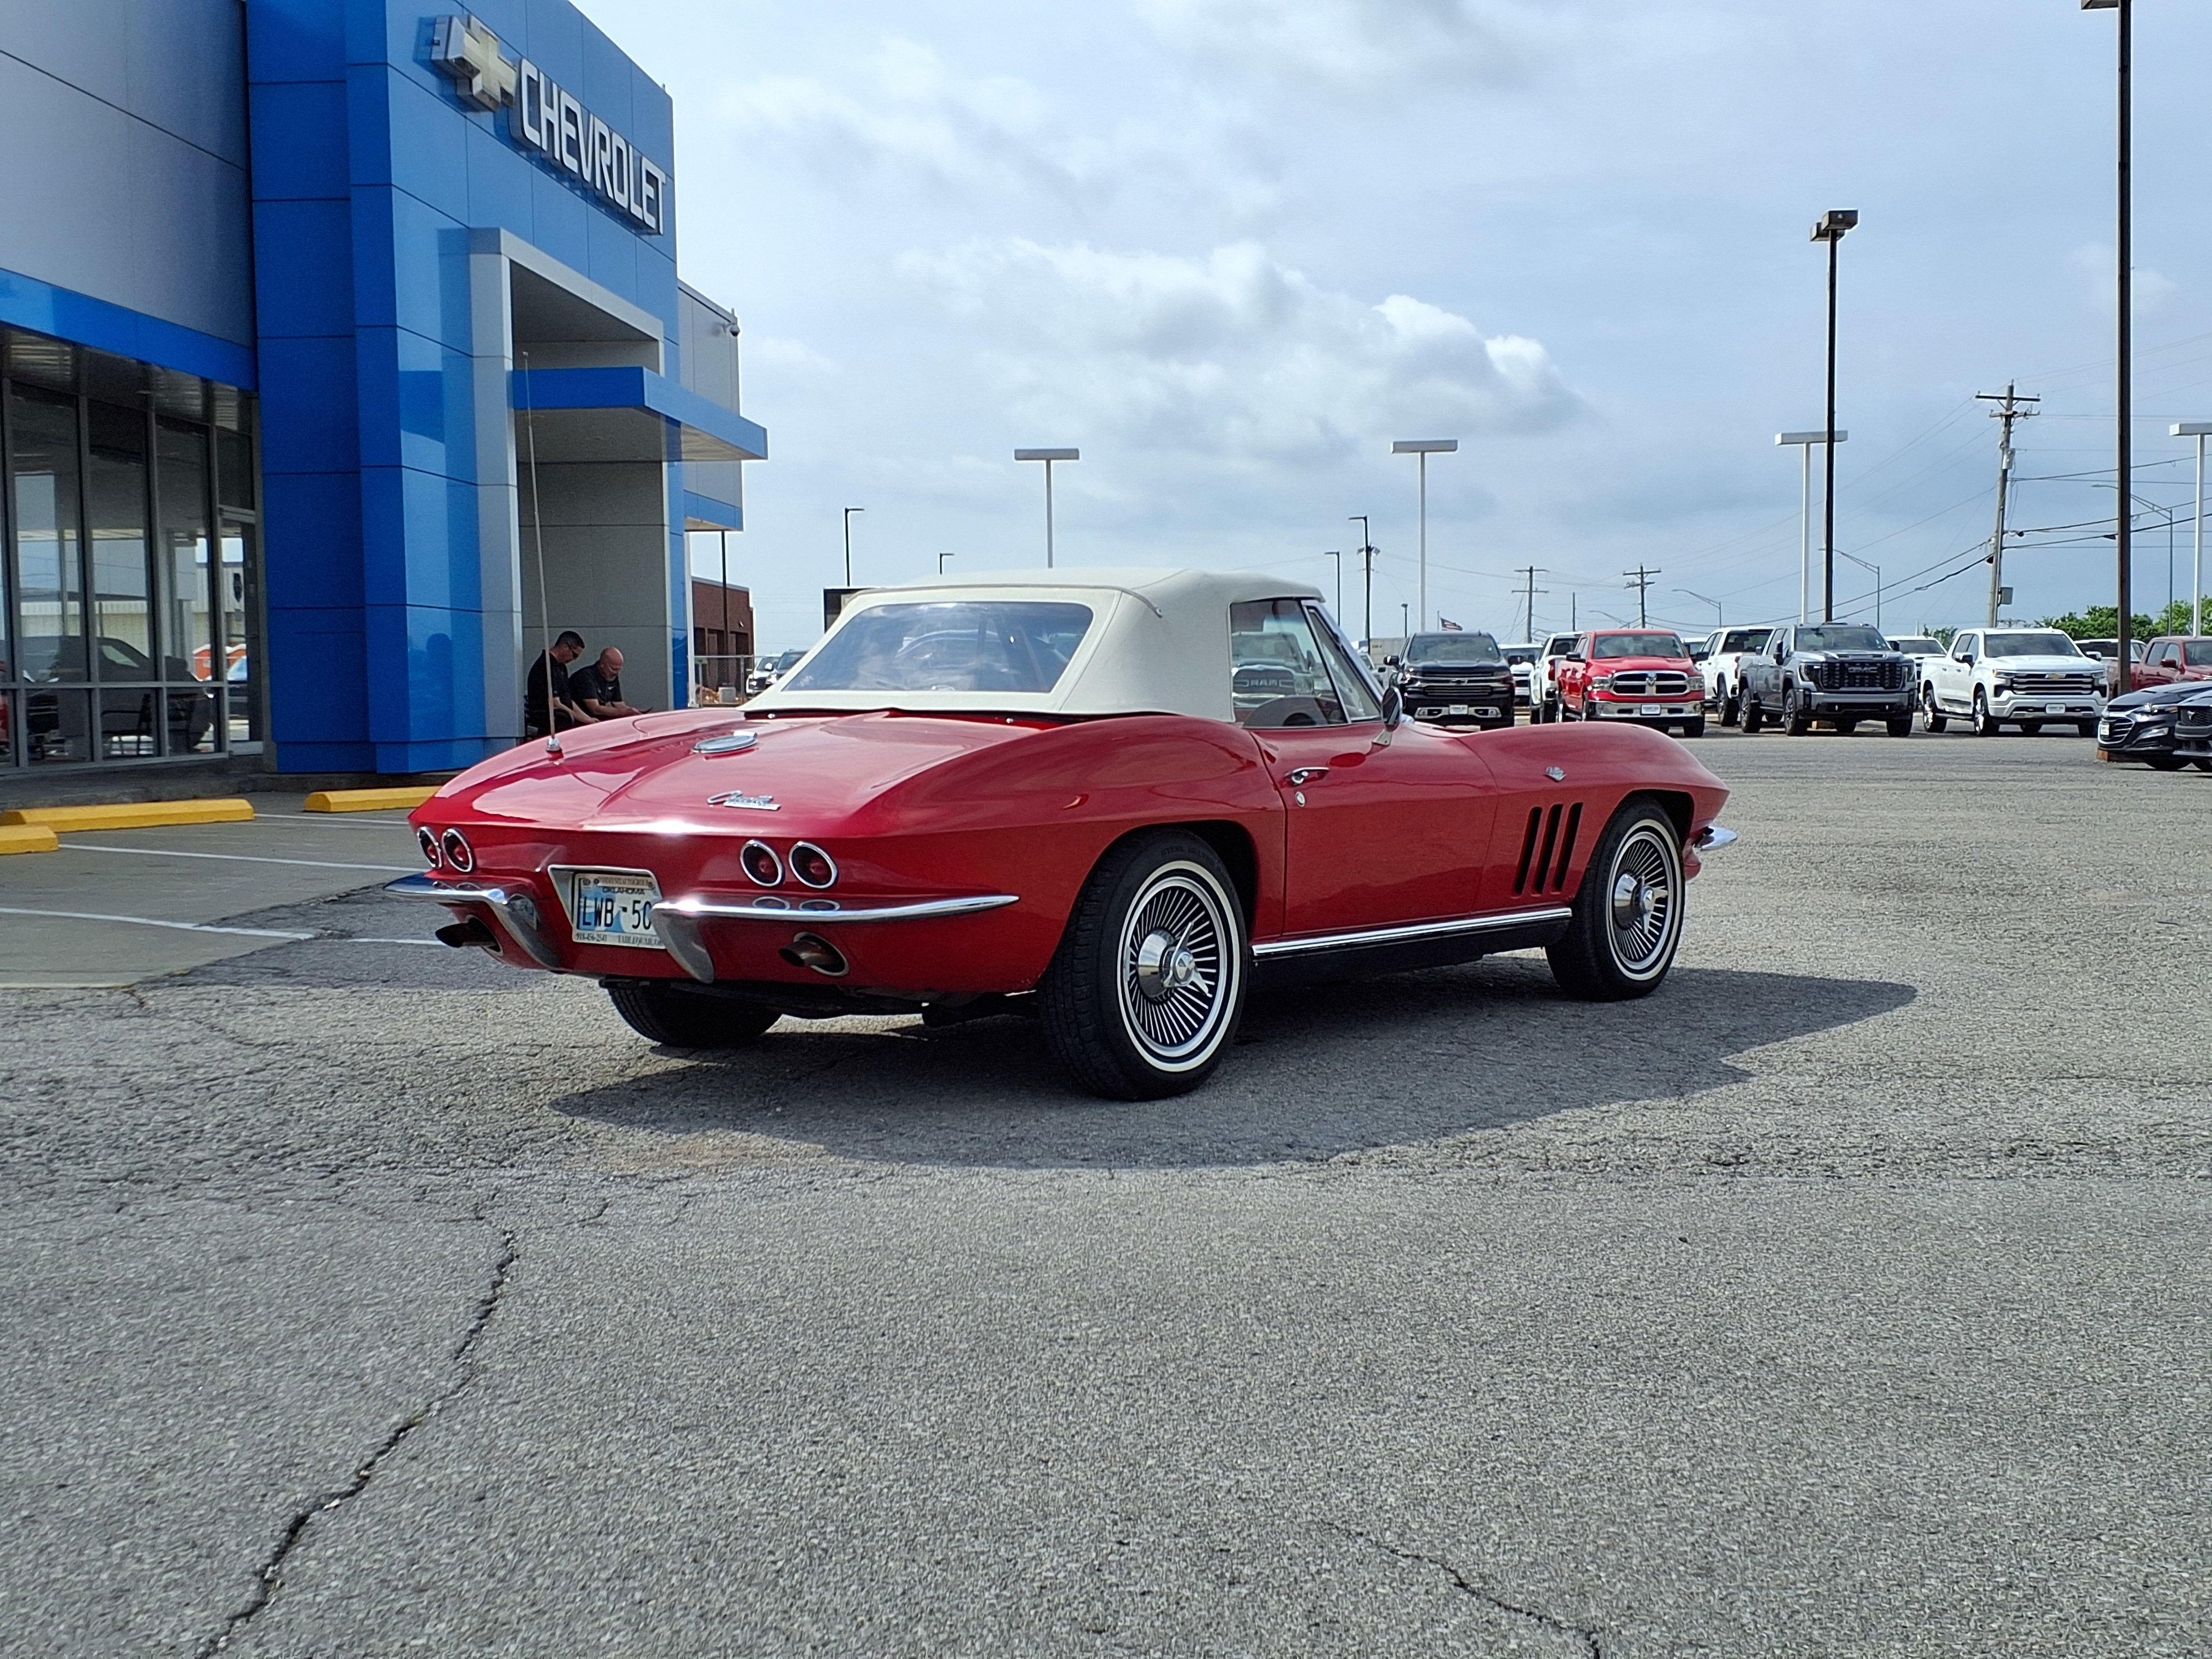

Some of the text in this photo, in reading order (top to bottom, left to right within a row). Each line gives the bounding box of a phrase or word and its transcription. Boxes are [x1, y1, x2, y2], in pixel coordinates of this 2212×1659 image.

[520, 57, 667, 236] CHEVROLET
[1250, 678, 1278, 686] RAM
[602, 887, 645, 895] OKLAHOMA
